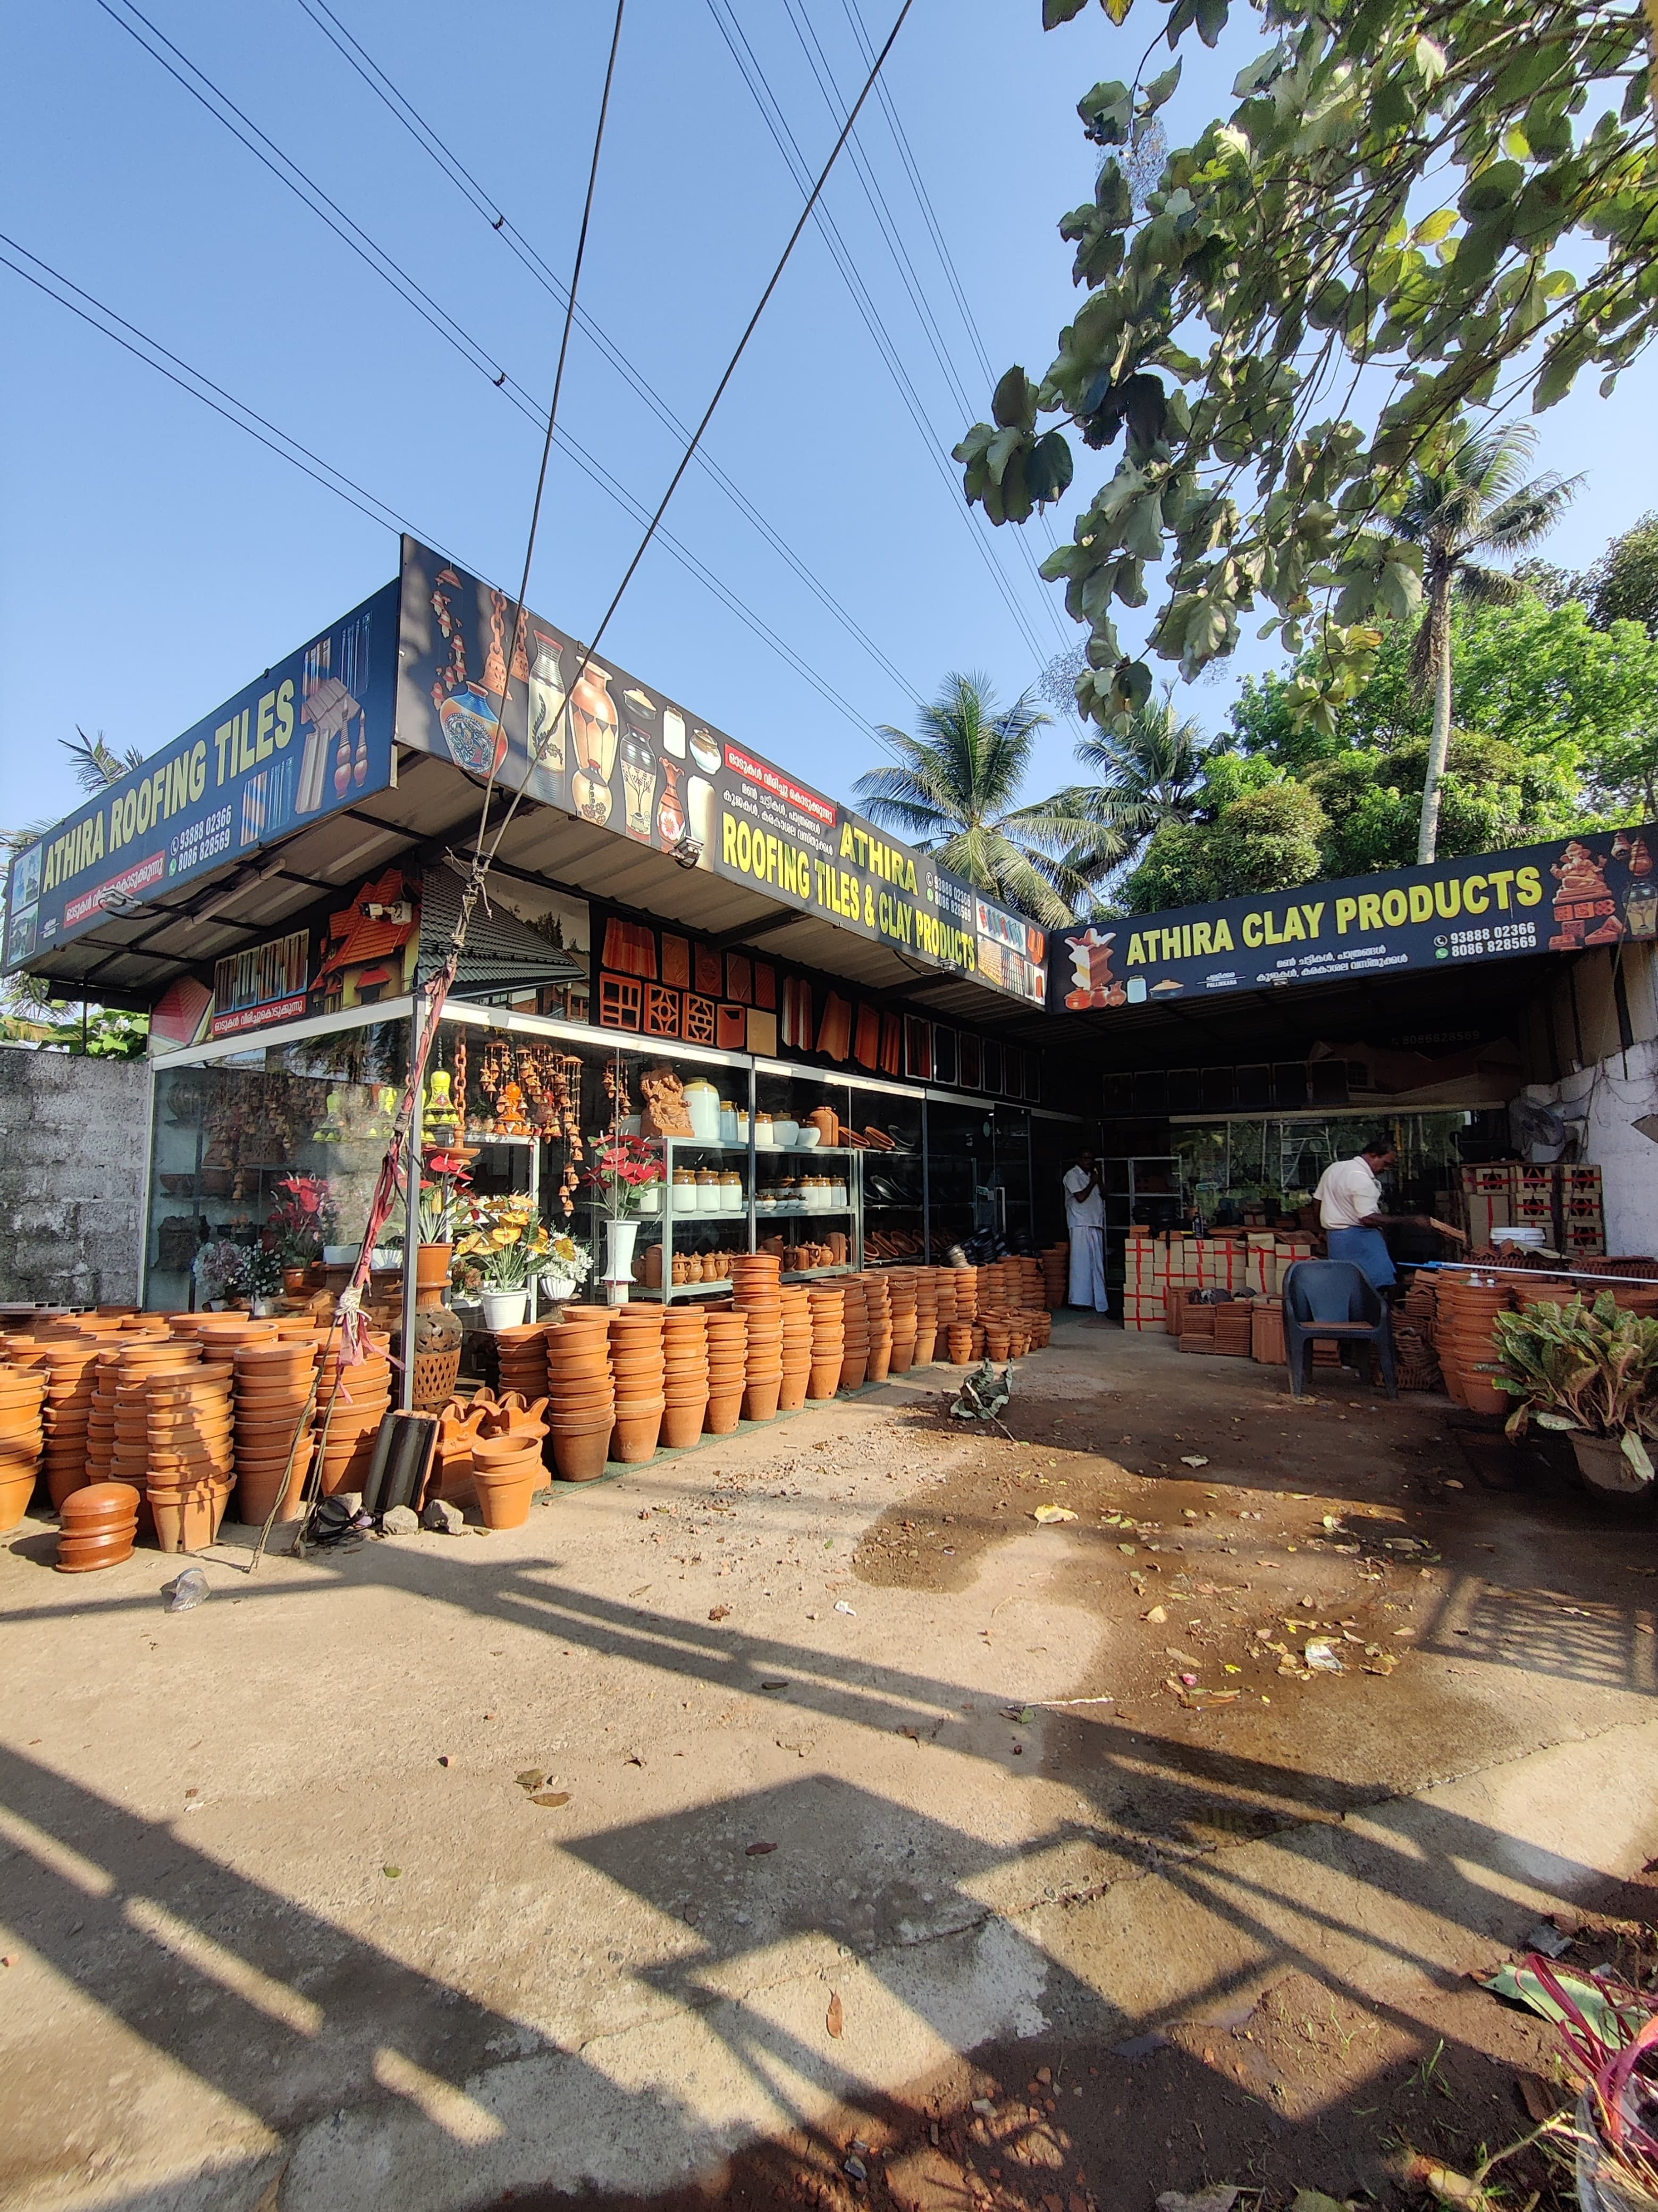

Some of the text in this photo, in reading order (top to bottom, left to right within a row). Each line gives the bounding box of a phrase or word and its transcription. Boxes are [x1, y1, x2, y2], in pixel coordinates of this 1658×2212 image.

[43, 679, 294, 893] ATHIRA ROOFING TILES
[729, 753, 762, 781] ഓടുകൾ
[178, 827, 230, 872] 8086 828569
[179, 805, 232, 851] 93888 02366
[839, 821, 919, 896] ATHIRA
[722, 811, 975, 973] ROOFING TILES & CLAY PRODUCTS
[934, 875, 971, 907] 93888 02366
[934, 892, 971, 923] 8086 828569
[1126, 866, 1543, 966] ATHIRA CLAY PRODUCTS
[1450, 922, 1536, 944] 93888 02366
[1451, 935, 1536, 957] 8086 828569
